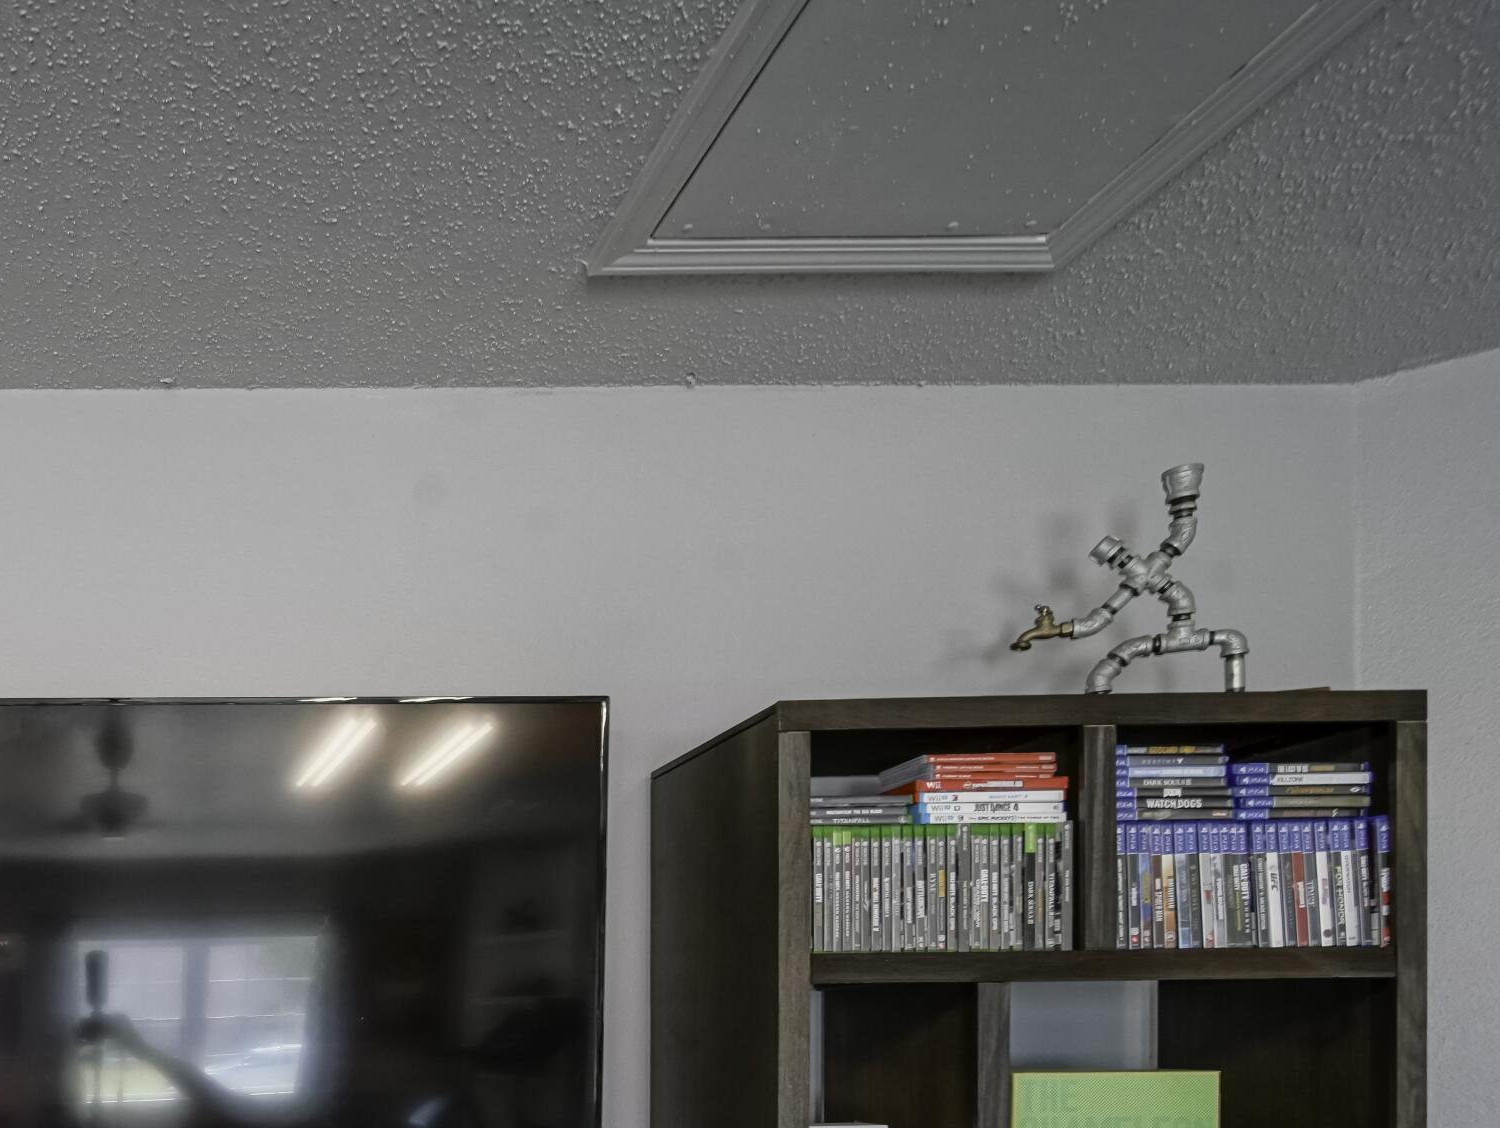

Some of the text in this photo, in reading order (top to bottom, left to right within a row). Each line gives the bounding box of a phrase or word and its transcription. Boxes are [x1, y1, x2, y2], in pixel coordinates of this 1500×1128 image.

[926, 781, 940, 790] Wii
[974, 803, 1019, 812] JUST DANCE 4
[981, 869, 989, 903] CALL DUTY
[1240, 863, 1250, 900] CALL DUTY
[1270, 872, 1278, 892] UFC
[1335, 866, 1345, 926] FOR HONOR
[1020, 1078, 1077, 1113] THE
